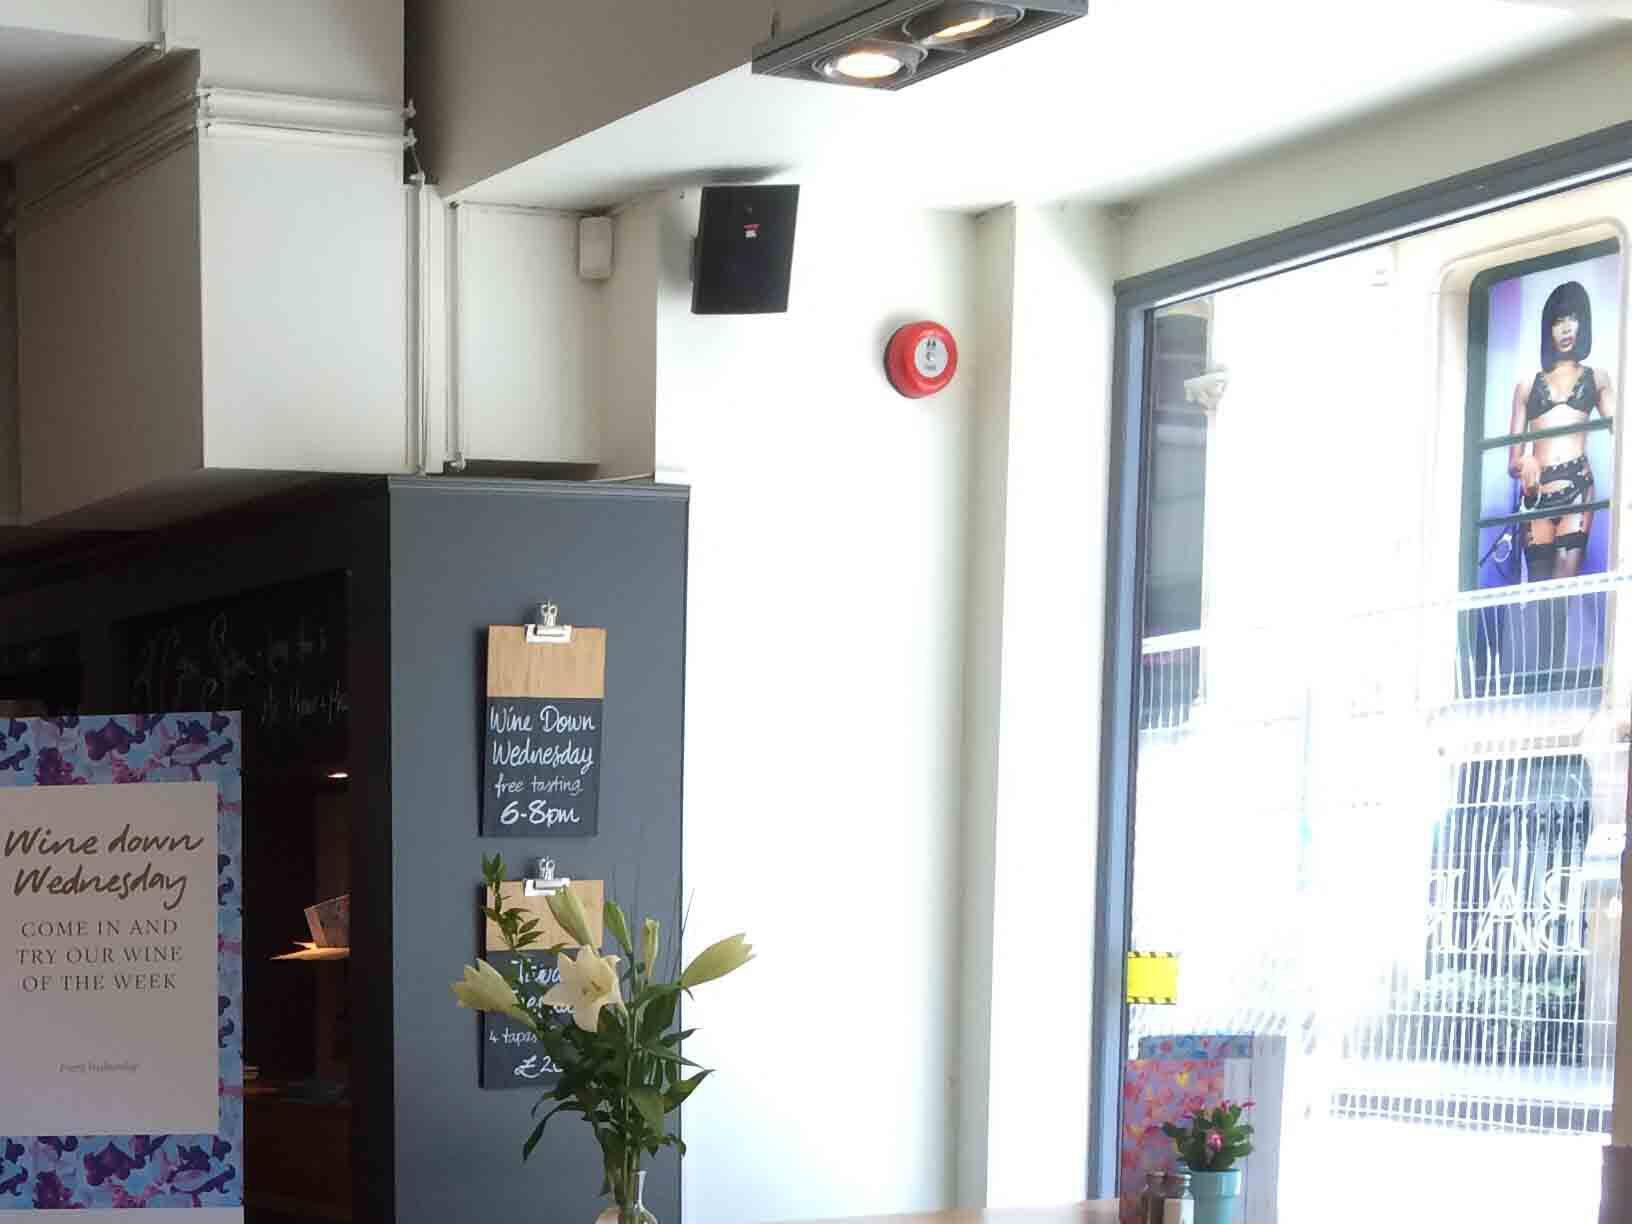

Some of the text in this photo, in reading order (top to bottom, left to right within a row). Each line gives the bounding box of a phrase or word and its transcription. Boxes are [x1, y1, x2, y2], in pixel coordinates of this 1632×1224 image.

[489, 705, 596, 734] Wine Down
[492, 737, 595, 775] Wednesday
[495, 772, 584, 798] free tasting
[500, 800, 580, 828] 6-8pm
[4, 823, 205, 857] Wine down
[14, 862, 188, 911] Wednesday
[21, 919, 178, 937] COME IN AND
[17, 946, 183, 966] TRY OUR WINE
[22, 974, 177, 992] OF THE WEEK
[488, 1029, 500, 1044] 4
